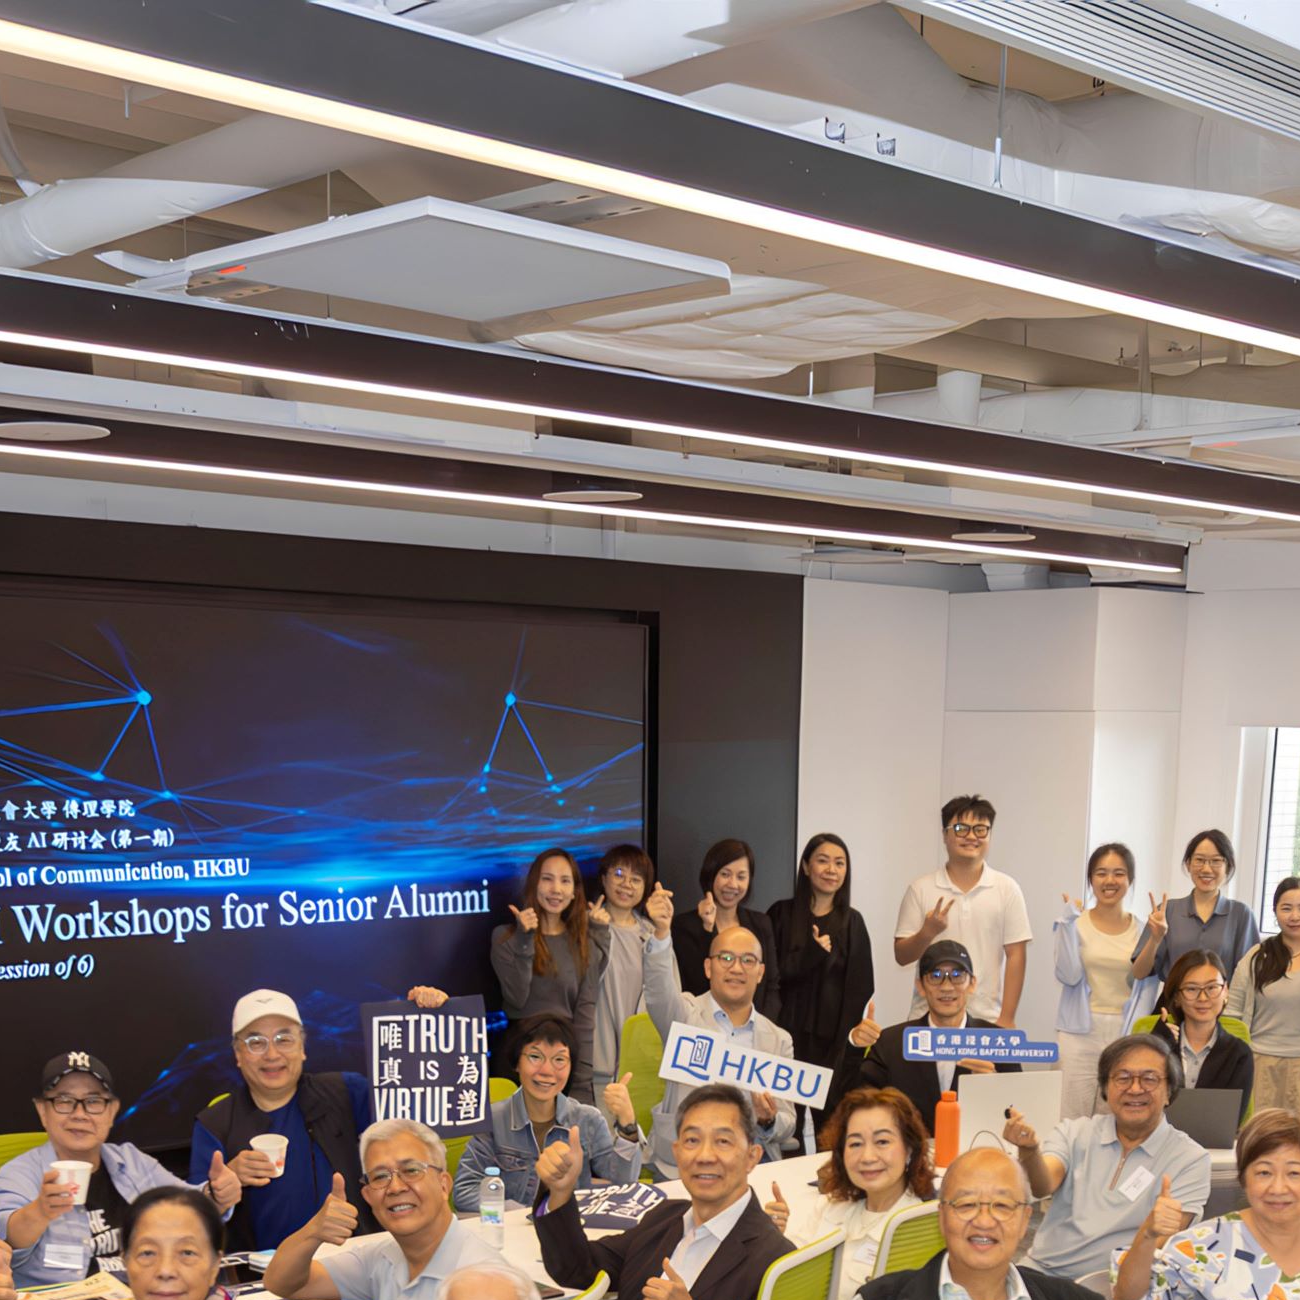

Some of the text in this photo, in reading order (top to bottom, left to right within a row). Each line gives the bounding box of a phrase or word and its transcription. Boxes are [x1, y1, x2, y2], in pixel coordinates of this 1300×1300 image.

[27, 832, 47, 849] AI
[17, 867, 37, 886] of
[40, 861, 190, 886] Communication,
[193, 858, 250, 878] HKBU
[10, 898, 211, 943] Workshops
[221, 893, 269, 930] for
[279, 887, 377, 927] Senior
[384, 879, 491, 919] Alumni
[54, 954, 77, 980] of
[77, 954, 95, 977] 6)
[405, 1014, 488, 1054] TRUTH
[935, 1047, 1054, 1058] HONG KONG BAPTIST UNIVERSITY
[419, 1060, 439, 1080] IS
[719, 1050, 821, 1098] HKBU
[373, 1086, 455, 1127] VIRTUE
